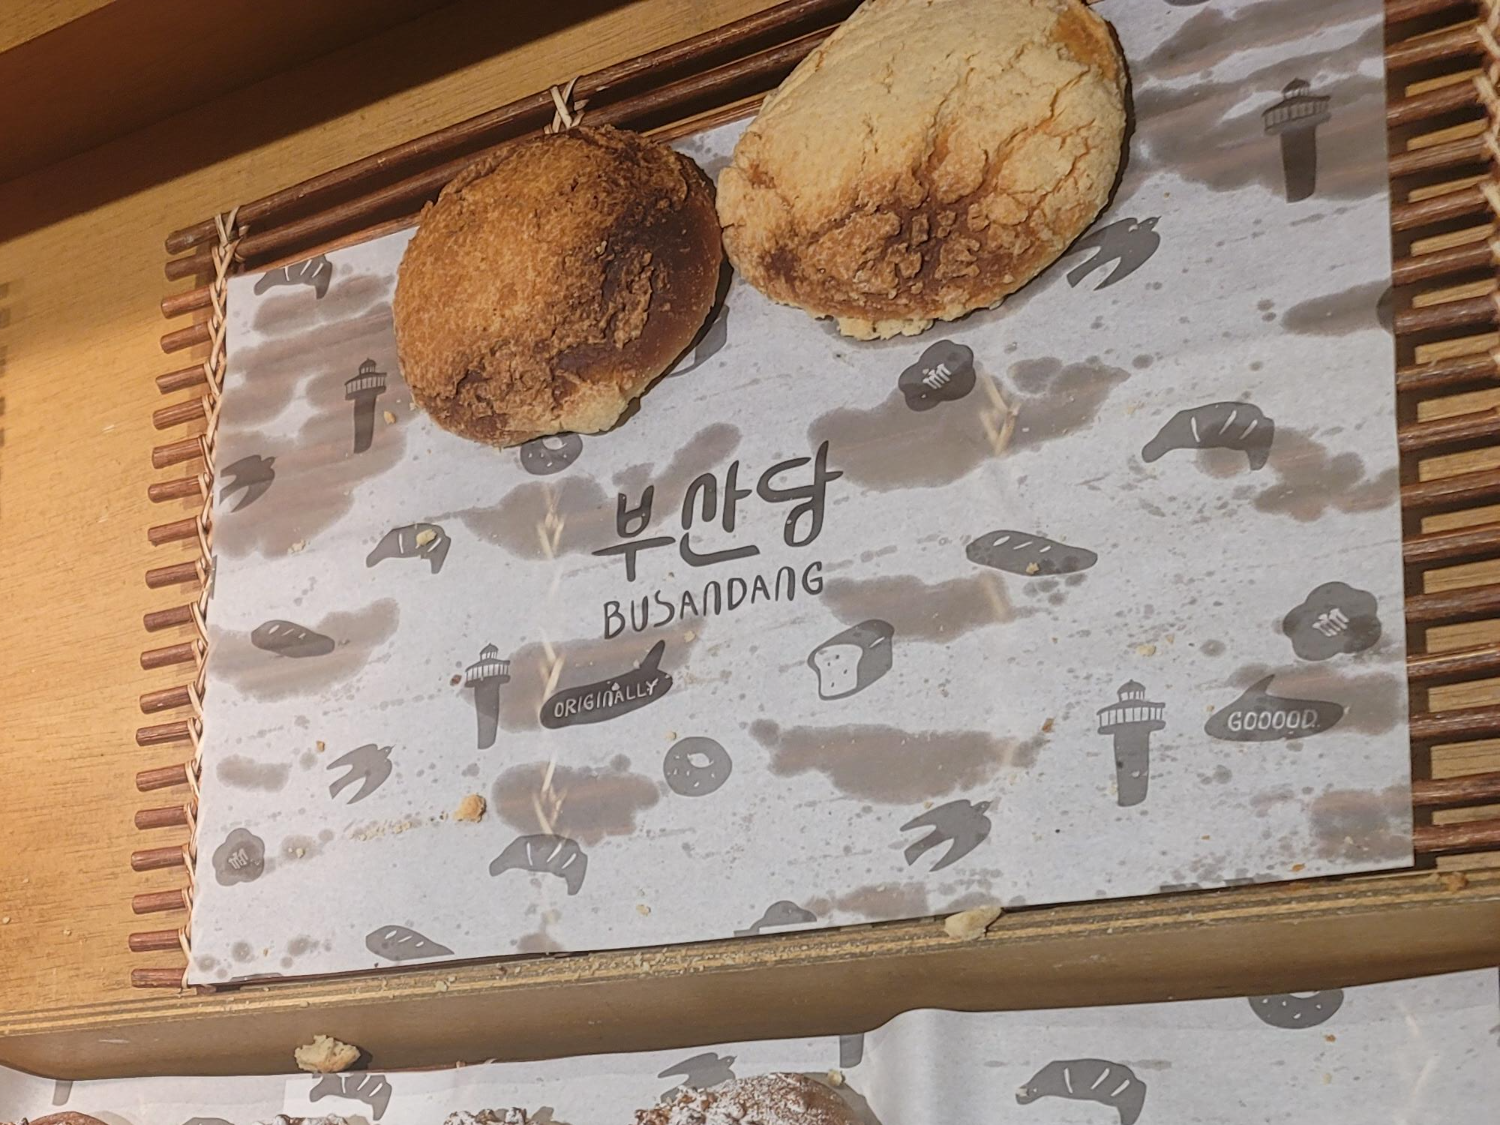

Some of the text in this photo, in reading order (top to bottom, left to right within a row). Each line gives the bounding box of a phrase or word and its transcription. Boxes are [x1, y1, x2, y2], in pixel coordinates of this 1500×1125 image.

[591, 440, 843, 582] 부산당
[603, 561, 823, 640] BUSANDANG
[554, 678, 659, 718] ORIGINALLY
